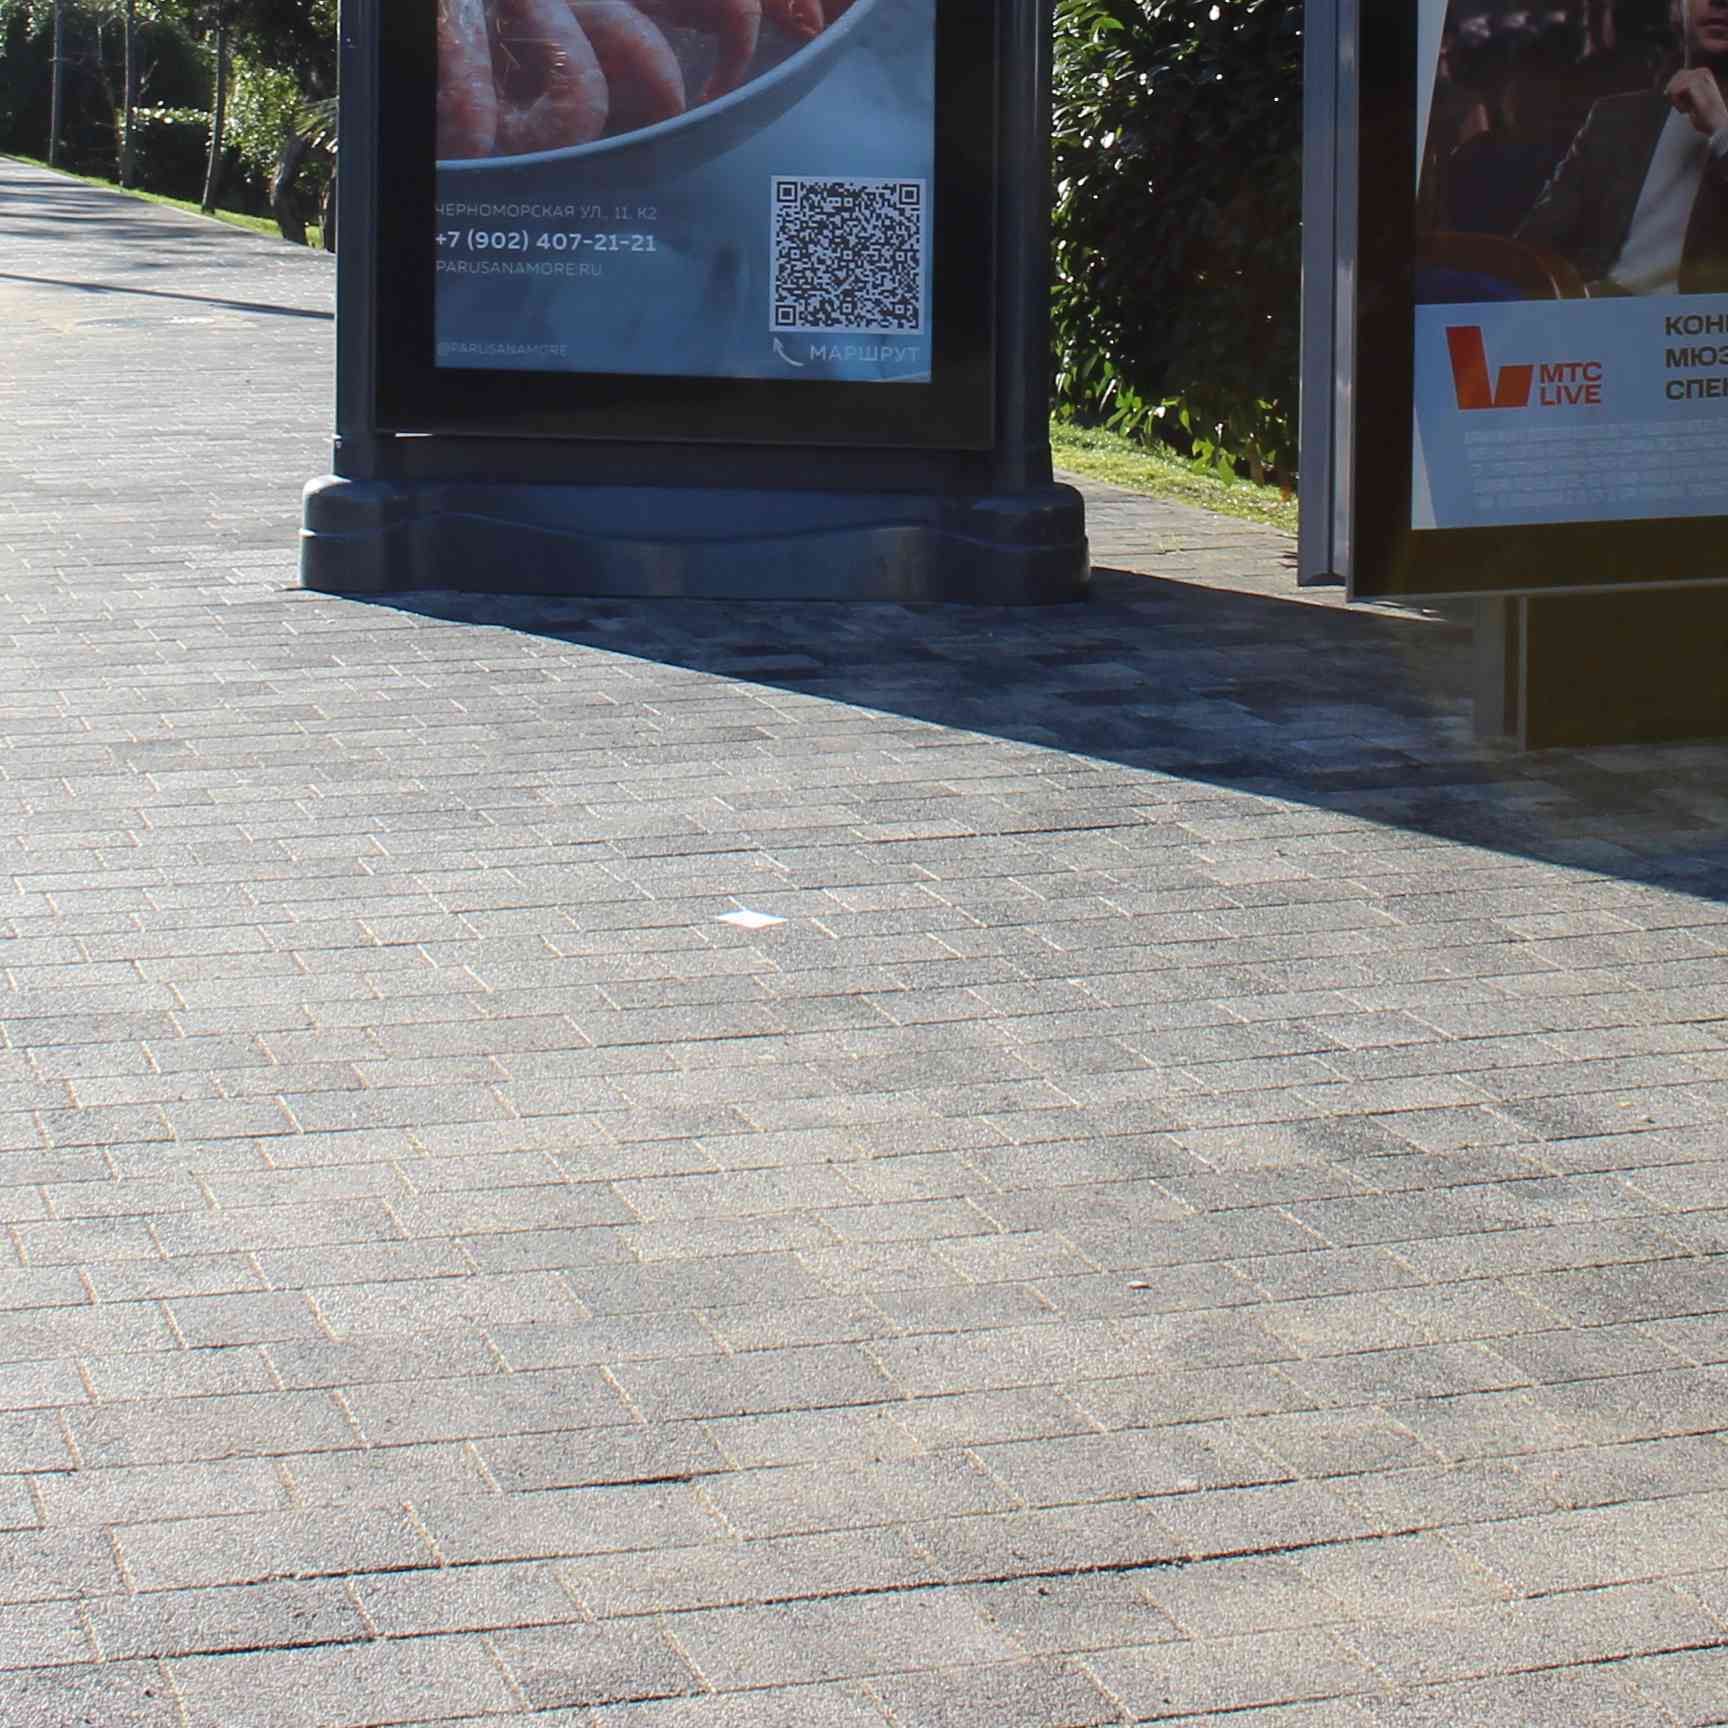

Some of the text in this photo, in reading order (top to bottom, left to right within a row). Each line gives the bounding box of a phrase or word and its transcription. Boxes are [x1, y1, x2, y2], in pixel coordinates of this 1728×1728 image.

[435, 202, 575, 219] ЧЕРНОМОРСКАЯ
[637, 206, 658, 221] К2
[435, 228, 657, 253] +7 (902) 407-21-21
[809, 343, 921, 363] МАРШРУТ
[1539, 361, 1602, 383] МТС
[1539, 383, 1602, 406] LIVE
